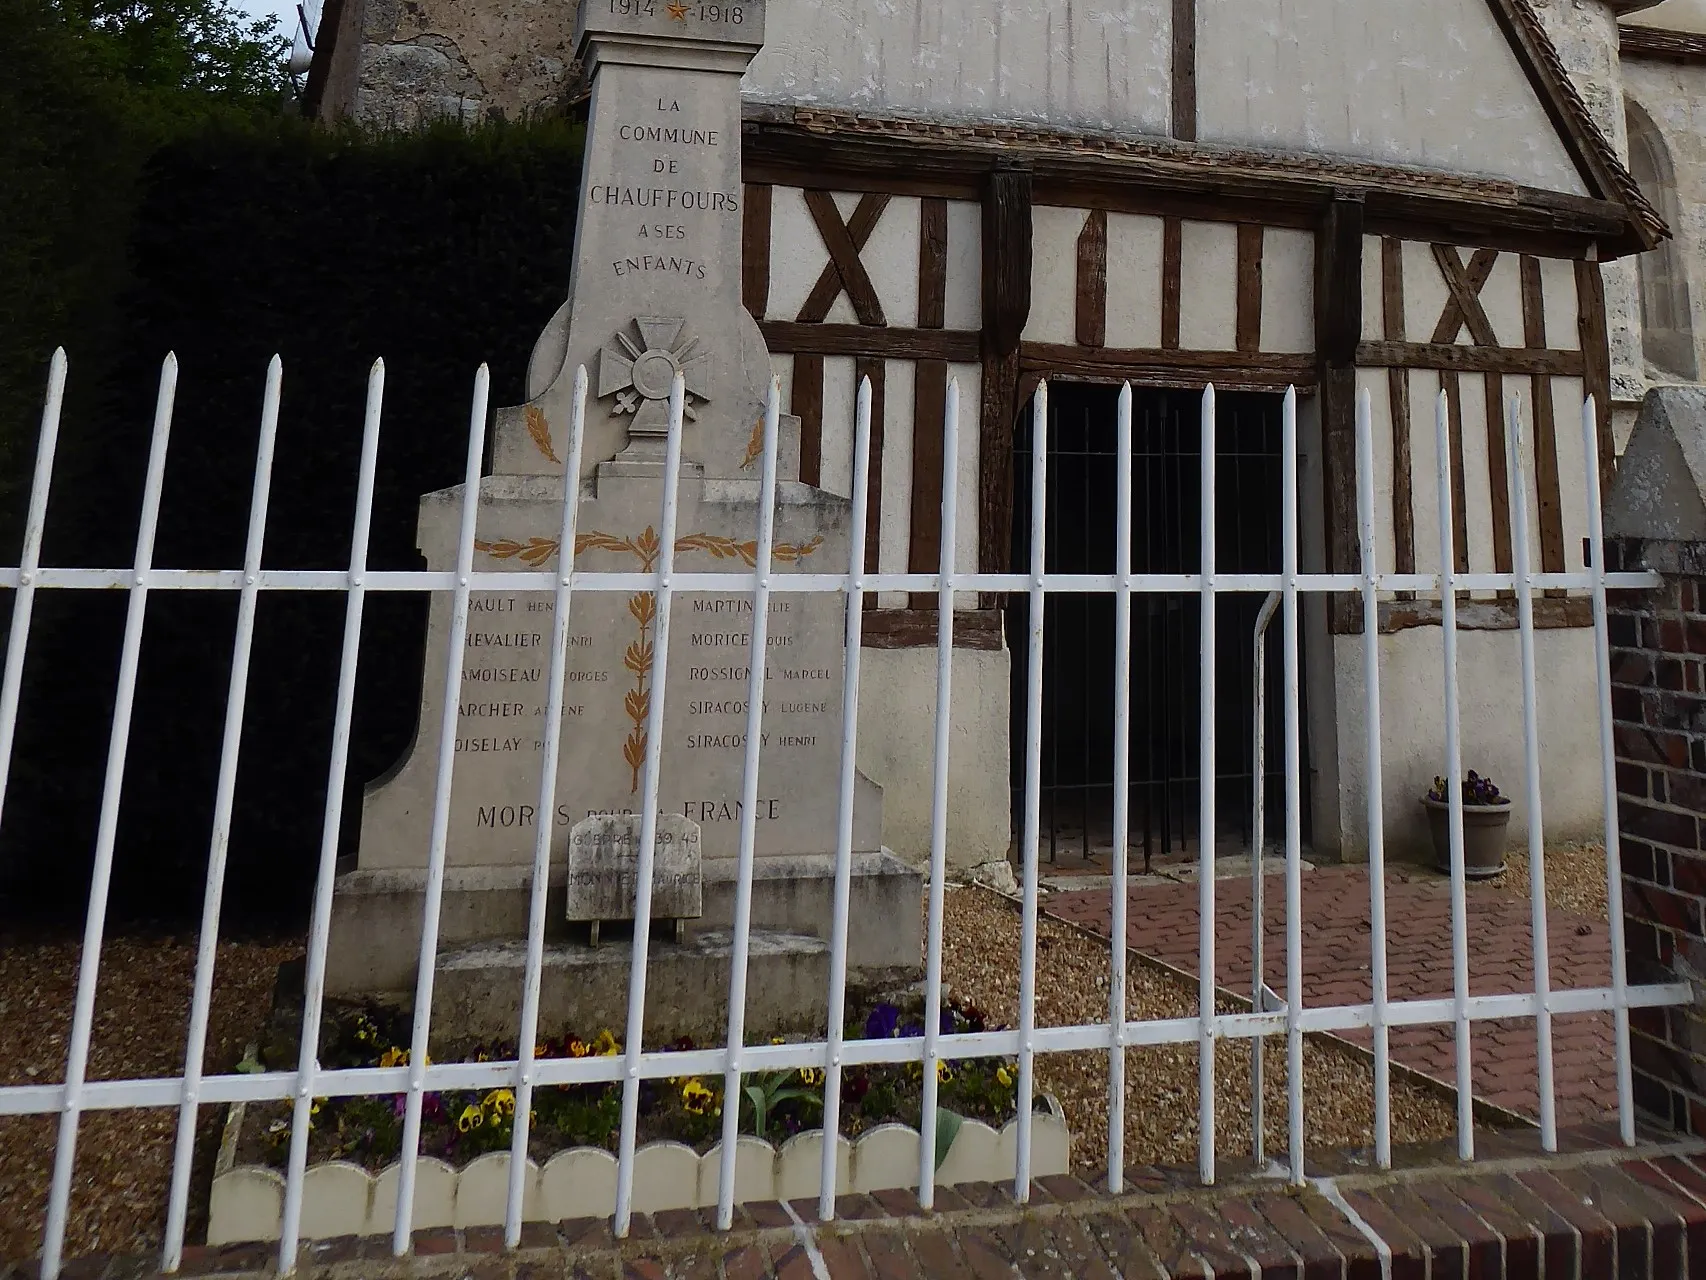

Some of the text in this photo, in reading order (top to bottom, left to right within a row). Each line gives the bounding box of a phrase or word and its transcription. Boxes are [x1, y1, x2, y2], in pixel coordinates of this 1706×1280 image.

[700, 5, 743, 24] 1918
[657, 97, 680, 111] LA
[620, 125, 719, 146] COMMUNE
[653, 159, 678, 174] DE
[590, 185, 738, 212] CHAUFFOURS
[638, 224, 685, 239] A SES
[612, 255, 707, 280] ENFANTS
[468, 598, 555, 612] RAULT HEN
[693, 600, 754, 613] MARTIN
[464, 633, 542, 647] HEVALIER
[691, 633, 793, 646] MORICE OUIS
[461, 668, 541, 682] AMOISEAU
[690, 667, 831, 680] ROSSIGNL MARCEL
[458, 703, 524, 717] ARCHER
[688, 700, 771, 714] SIRACOSY
[454, 737, 522, 752] OISELAY
[687, 732, 817, 748] SIRACOSY HENRI
[477, 804, 570, 827] MORS
